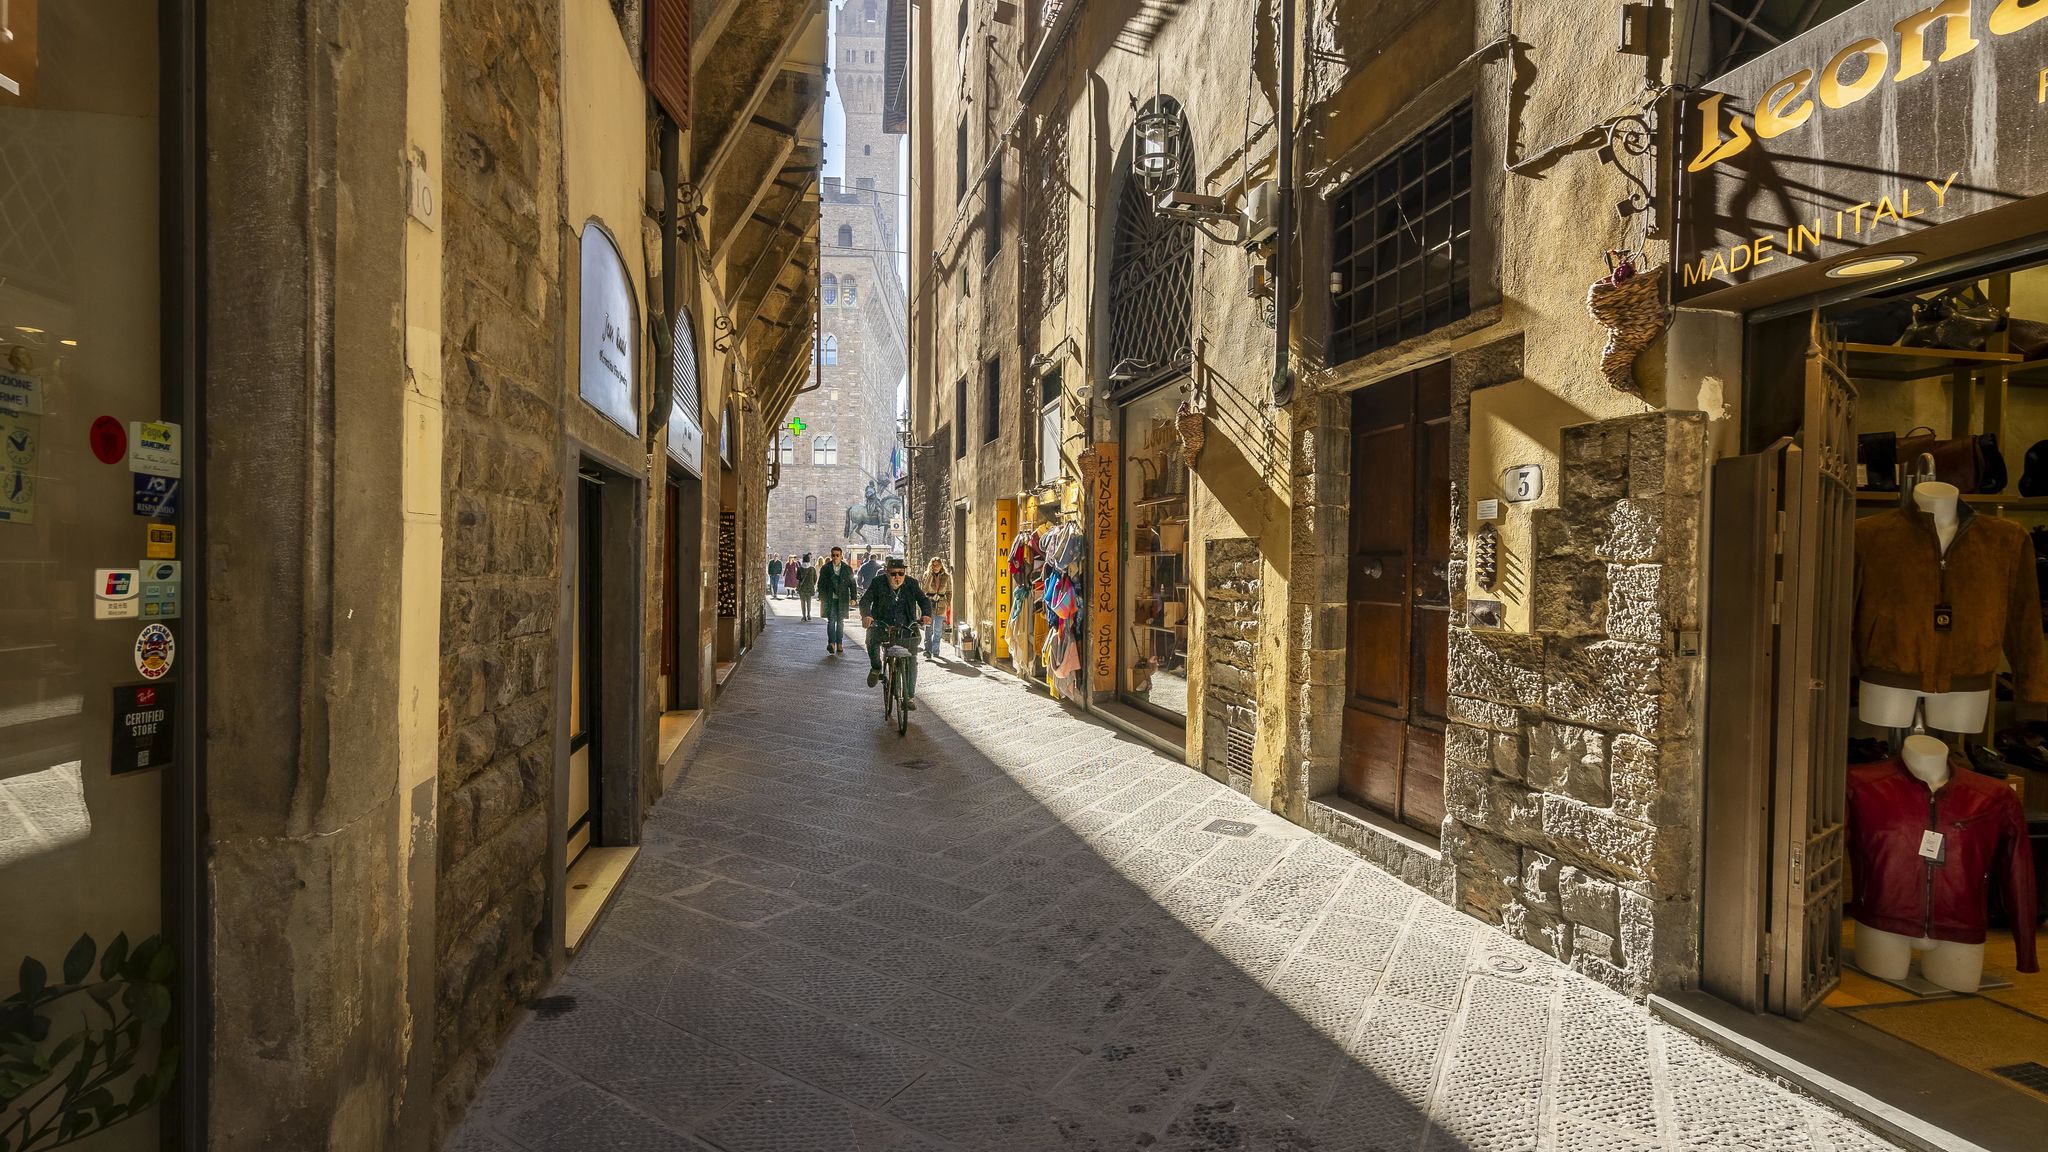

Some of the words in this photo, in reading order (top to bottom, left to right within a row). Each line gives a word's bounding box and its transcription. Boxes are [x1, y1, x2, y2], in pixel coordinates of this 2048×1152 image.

[416, 178, 432, 216] 10
[1683, 234, 1774, 288] MADE
[1786, 218, 1822, 255] IN
[1835, 171, 1960, 240] ITALY
[1098, 455, 1114, 540] HANDMADE
[1517, 471, 1530, 497] 3
[999, 517, 1009, 557] ATM
[999, 568, 1008, 629] HERE
[1098, 550, 1114, 614] CUSTOM
[1097, 624, 1113, 677] SHOES
[125, 709, 165, 726] CERTIFIED
[132, 722, 158, 737] STORE
